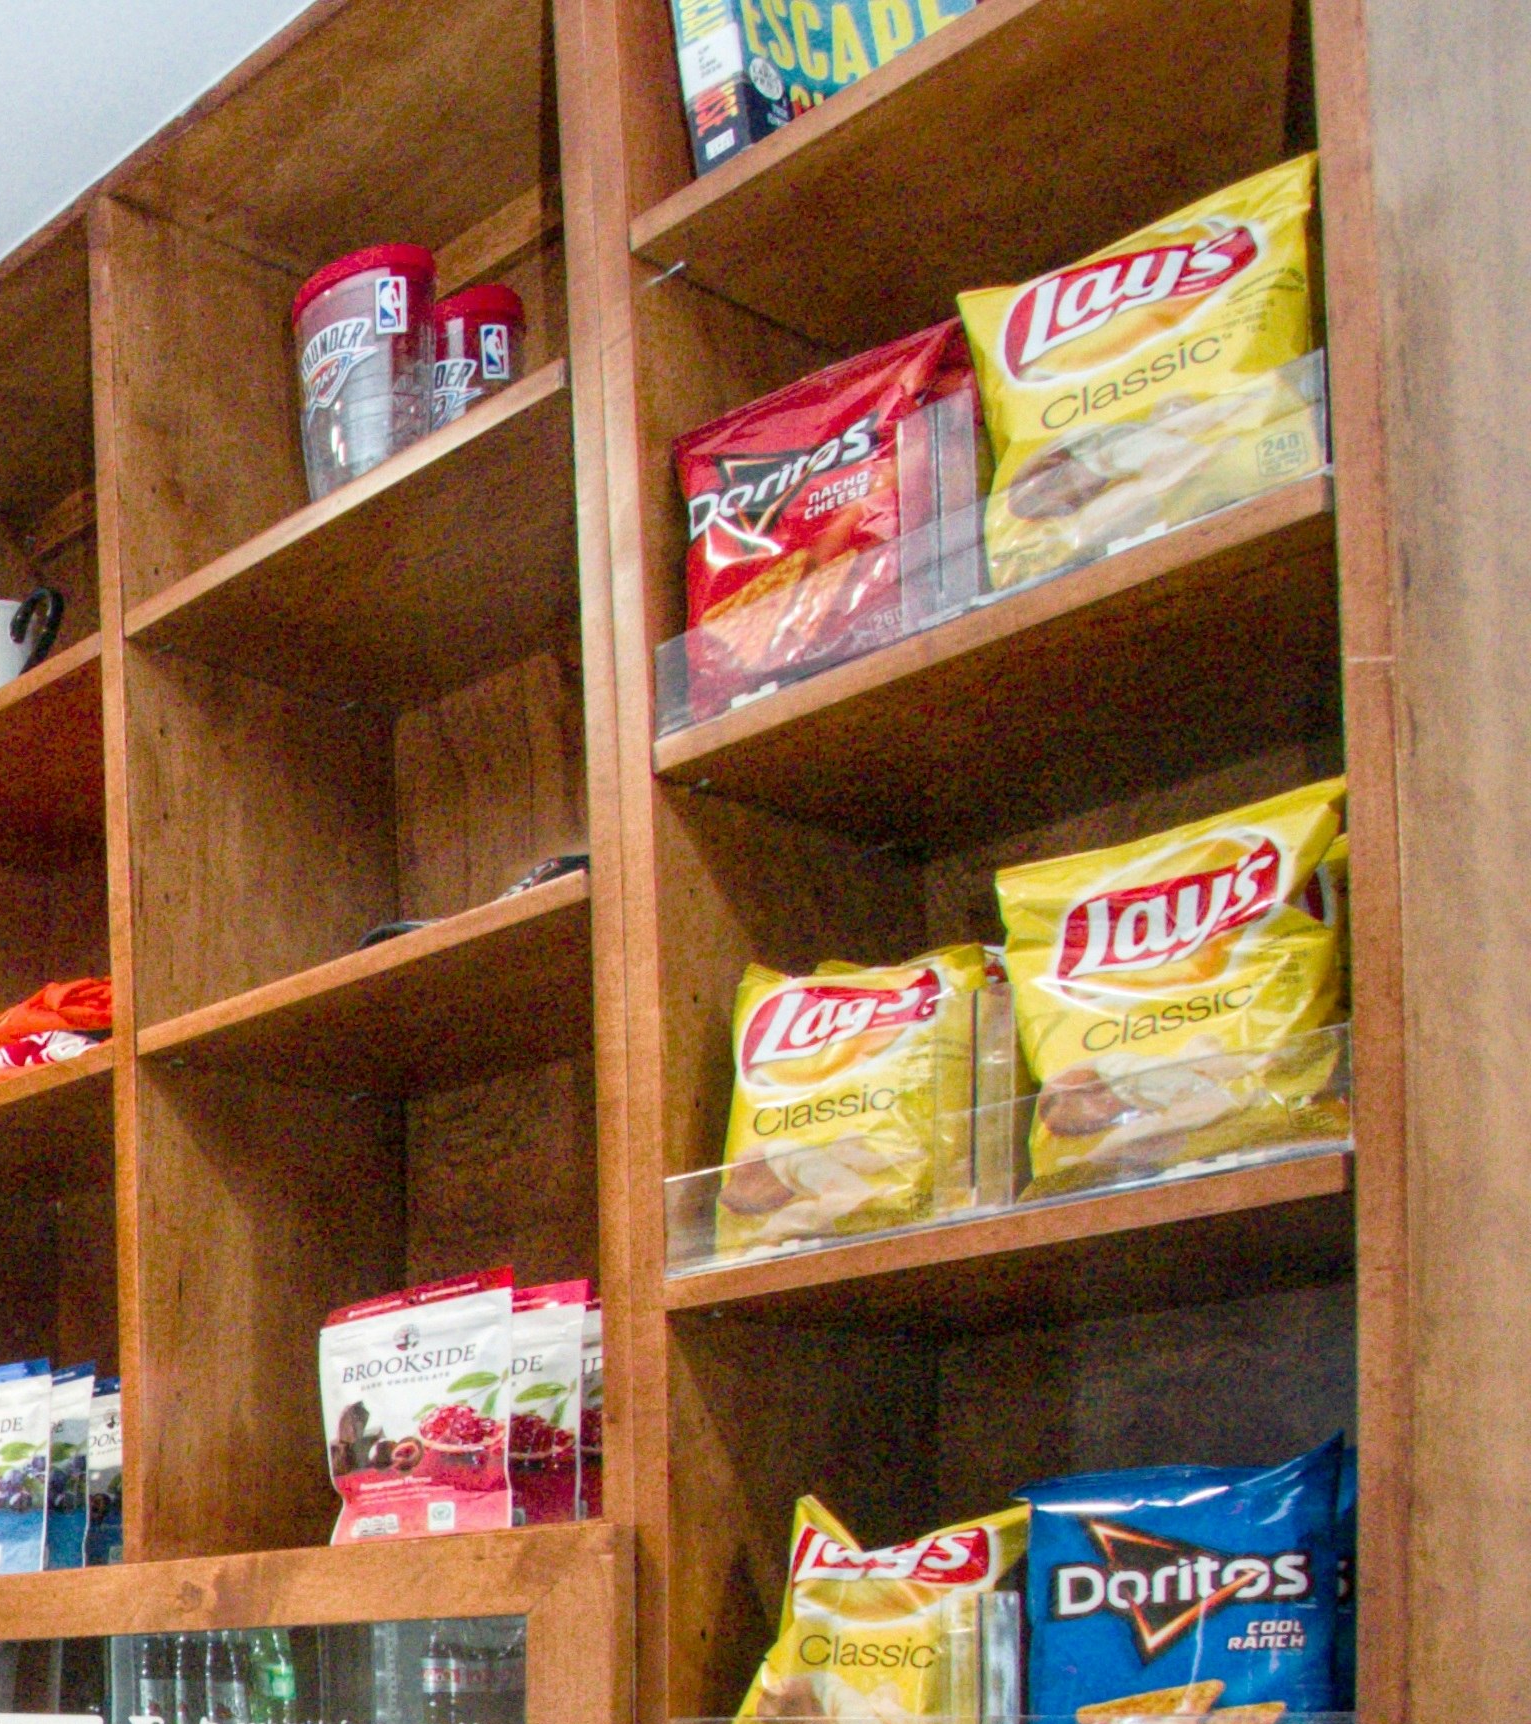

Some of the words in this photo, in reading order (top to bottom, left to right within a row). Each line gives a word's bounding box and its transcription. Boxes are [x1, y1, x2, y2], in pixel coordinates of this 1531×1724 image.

[1019, 226, 1256, 367] Lay's
[1040, 332, 1223, 432] Classic
[688, 416, 881, 544] Doritos
[804, 482, 870, 522] CHEESE
[808, 470, 870, 508] NACHO
[1066, 853, 1278, 980] Lay's
[1081, 982, 1254, 1054] Classic
[751, 1082, 899, 1138] Classic
[342, 1344, 477, 1385] BROOKSIDE
[1056, 1552, 1310, 1618] Doritos
[798, 1633, 936, 1671] Classic
[1226, 1634, 1306, 1652] RANCH
[1246, 1619, 1304, 1636] COOL
